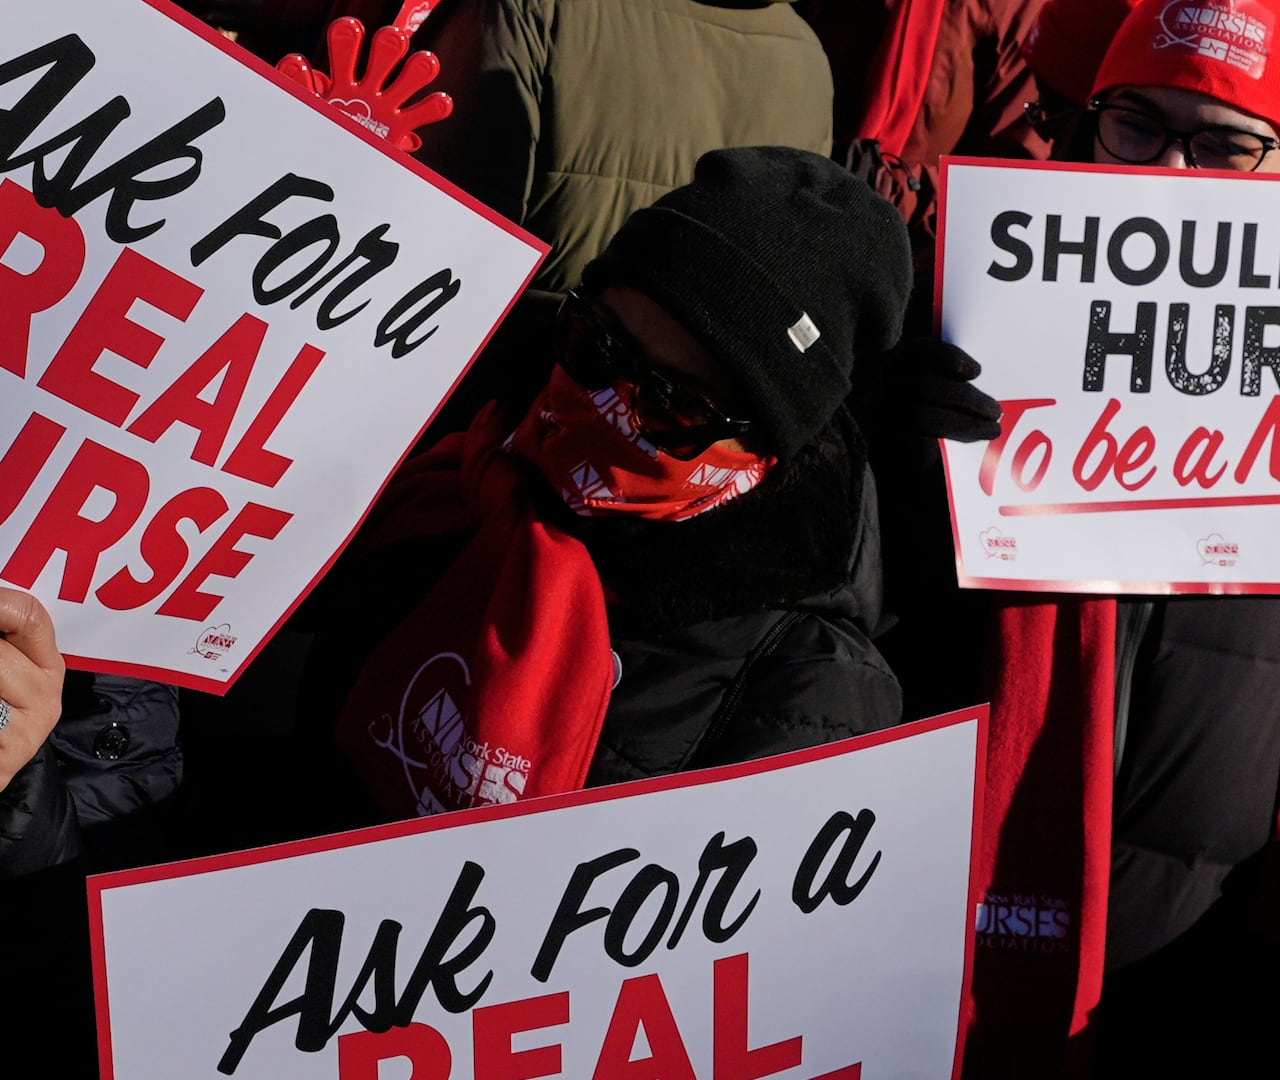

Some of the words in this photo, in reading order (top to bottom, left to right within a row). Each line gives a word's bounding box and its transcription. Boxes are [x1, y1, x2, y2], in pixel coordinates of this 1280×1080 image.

[1174, 21, 1268, 54] ASSOCIATION
[1177, 7, 1266, 45] NURSES
[190, 172, 400, 331] For
[373, 268, 461, 359] a
[977, 397, 1058, 496] To
[1071, 397, 1158, 492] be
[1172, 425, 1228, 489] a
[492, 747, 532, 773] State
[976, 903, 1070, 938] URSES
[217, 861, 497, 1075] Ask
[530, 831, 761, 984] For
[791, 808, 882, 914] a
